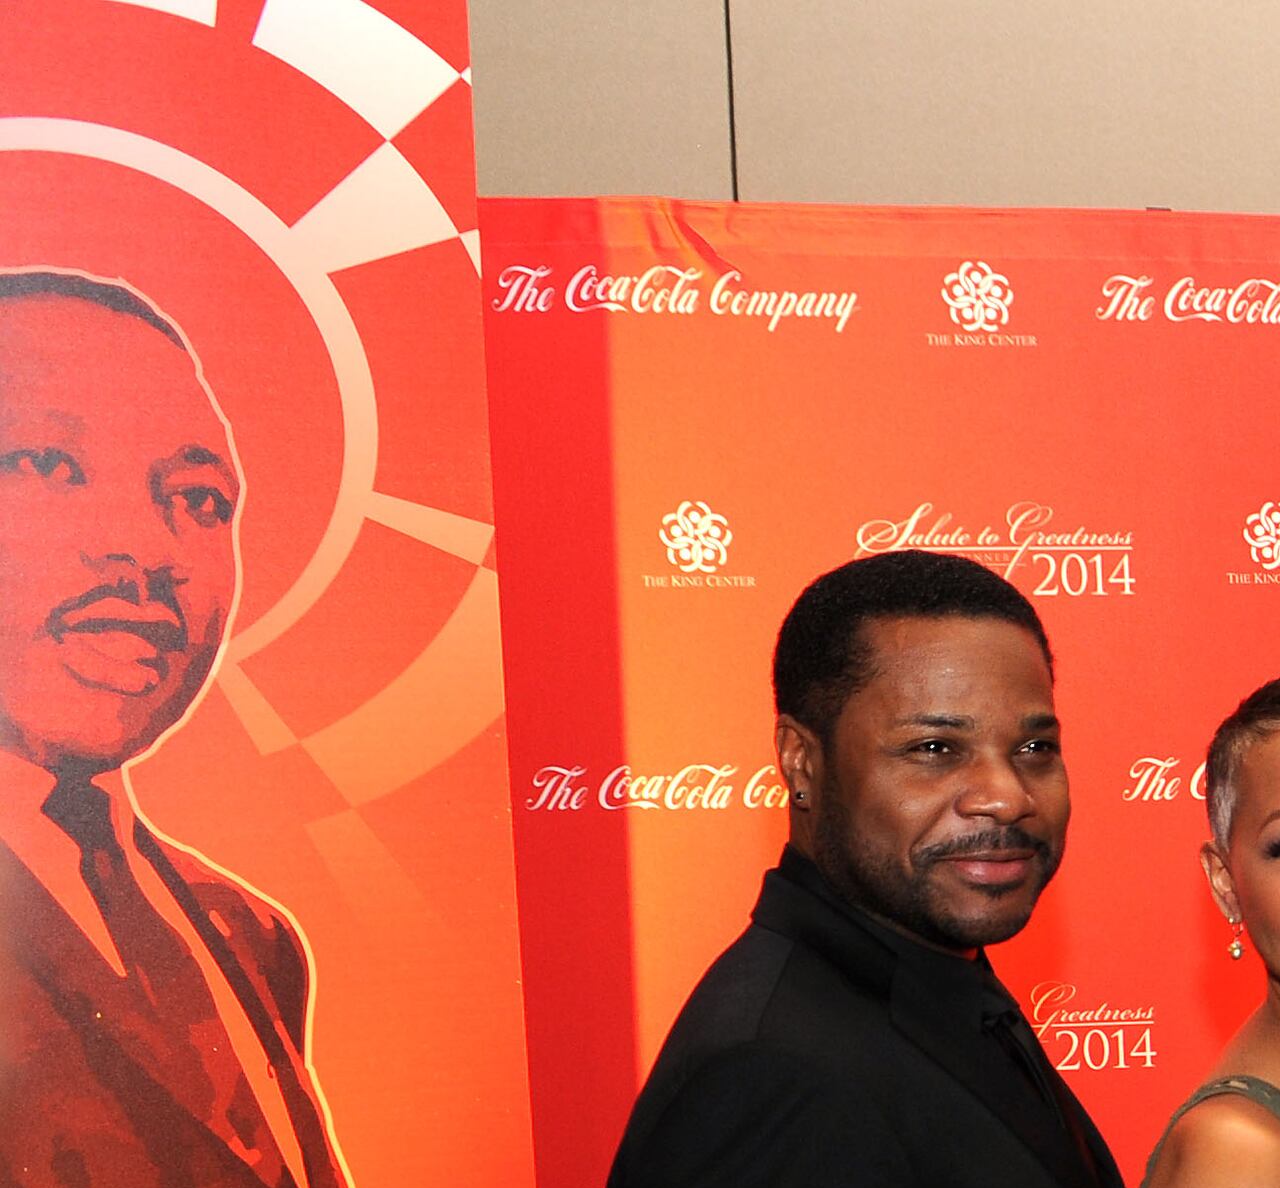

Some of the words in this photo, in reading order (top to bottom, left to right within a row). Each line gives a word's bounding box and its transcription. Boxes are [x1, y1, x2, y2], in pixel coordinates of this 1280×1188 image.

[493, 265, 555, 313] The
[709, 270, 858, 333] Company
[1096, 275, 1155, 321] The
[926, 333, 953, 347] THE
[953, 333, 987, 347] KING
[988, 333, 1038, 349] CENTER
[854, 502, 971, 558] Salute
[977, 526, 1000, 546] to
[1005, 501, 1134, 581] Greatness
[641, 574, 670, 589] THE
[670, 573, 705, 589] KING
[705, 573, 758, 589] CENTER
[1032, 553, 1136, 596] 2014
[1225, 571, 1252, 585] THE
[526, 766, 588, 811] The
[1123, 757, 1181, 801] The
[1030, 980, 1154, 1039] Greatness
[1055, 1028, 1157, 1071] 2014
